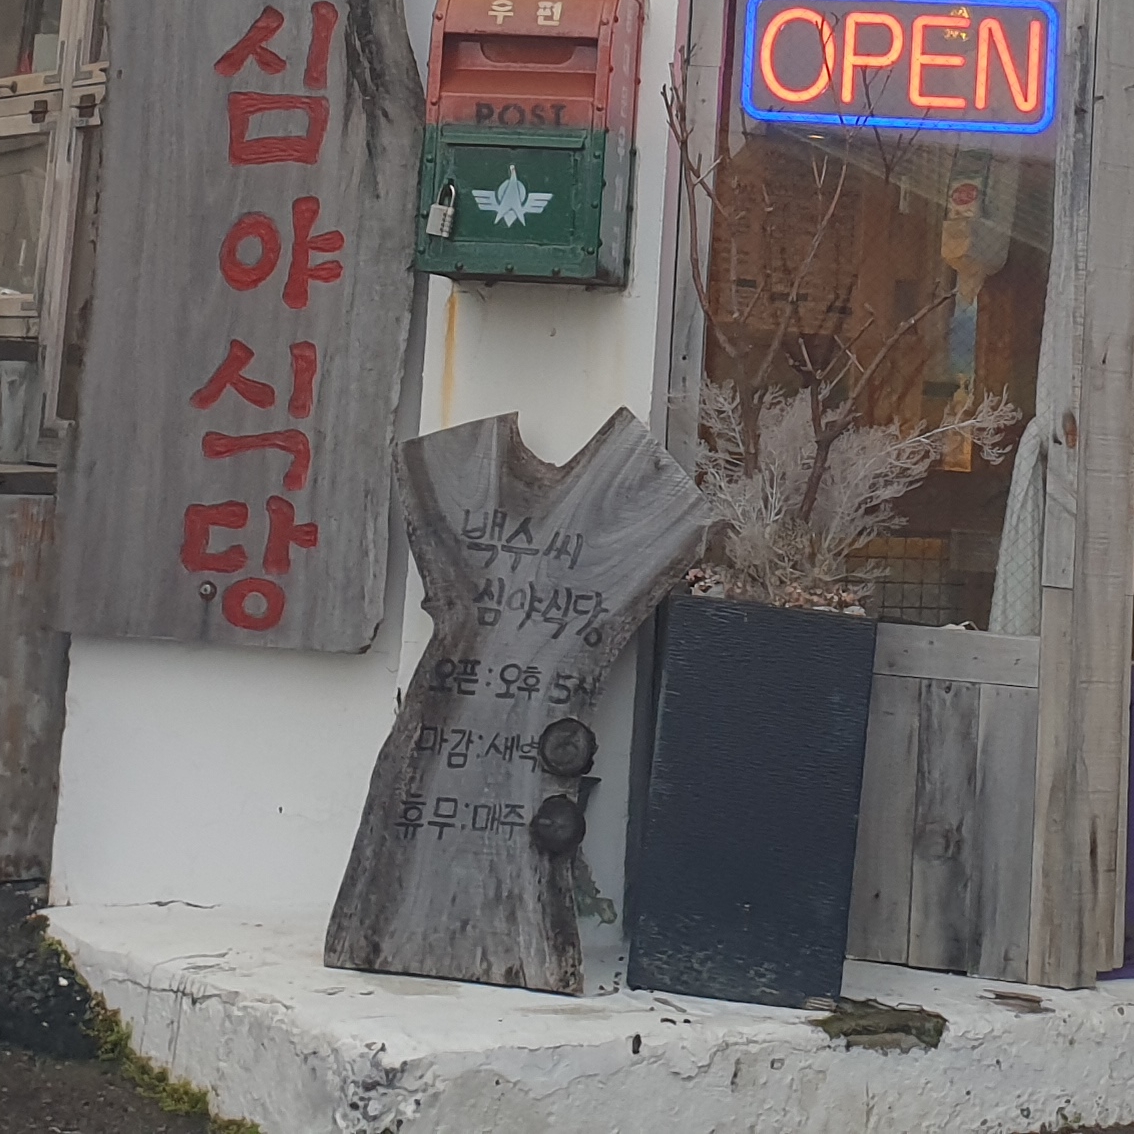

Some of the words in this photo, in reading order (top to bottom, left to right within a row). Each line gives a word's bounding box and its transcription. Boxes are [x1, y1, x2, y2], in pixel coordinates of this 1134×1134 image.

[487, 0, 563, 27] 우편
[760, 8, 1042, 113] OPEN
[475, 102, 568, 127] POST
[181, 0, 344, 631] 심야식당
[461, 508, 583, 571] 백수씨
[472, 577, 608, 647] 심야식당
